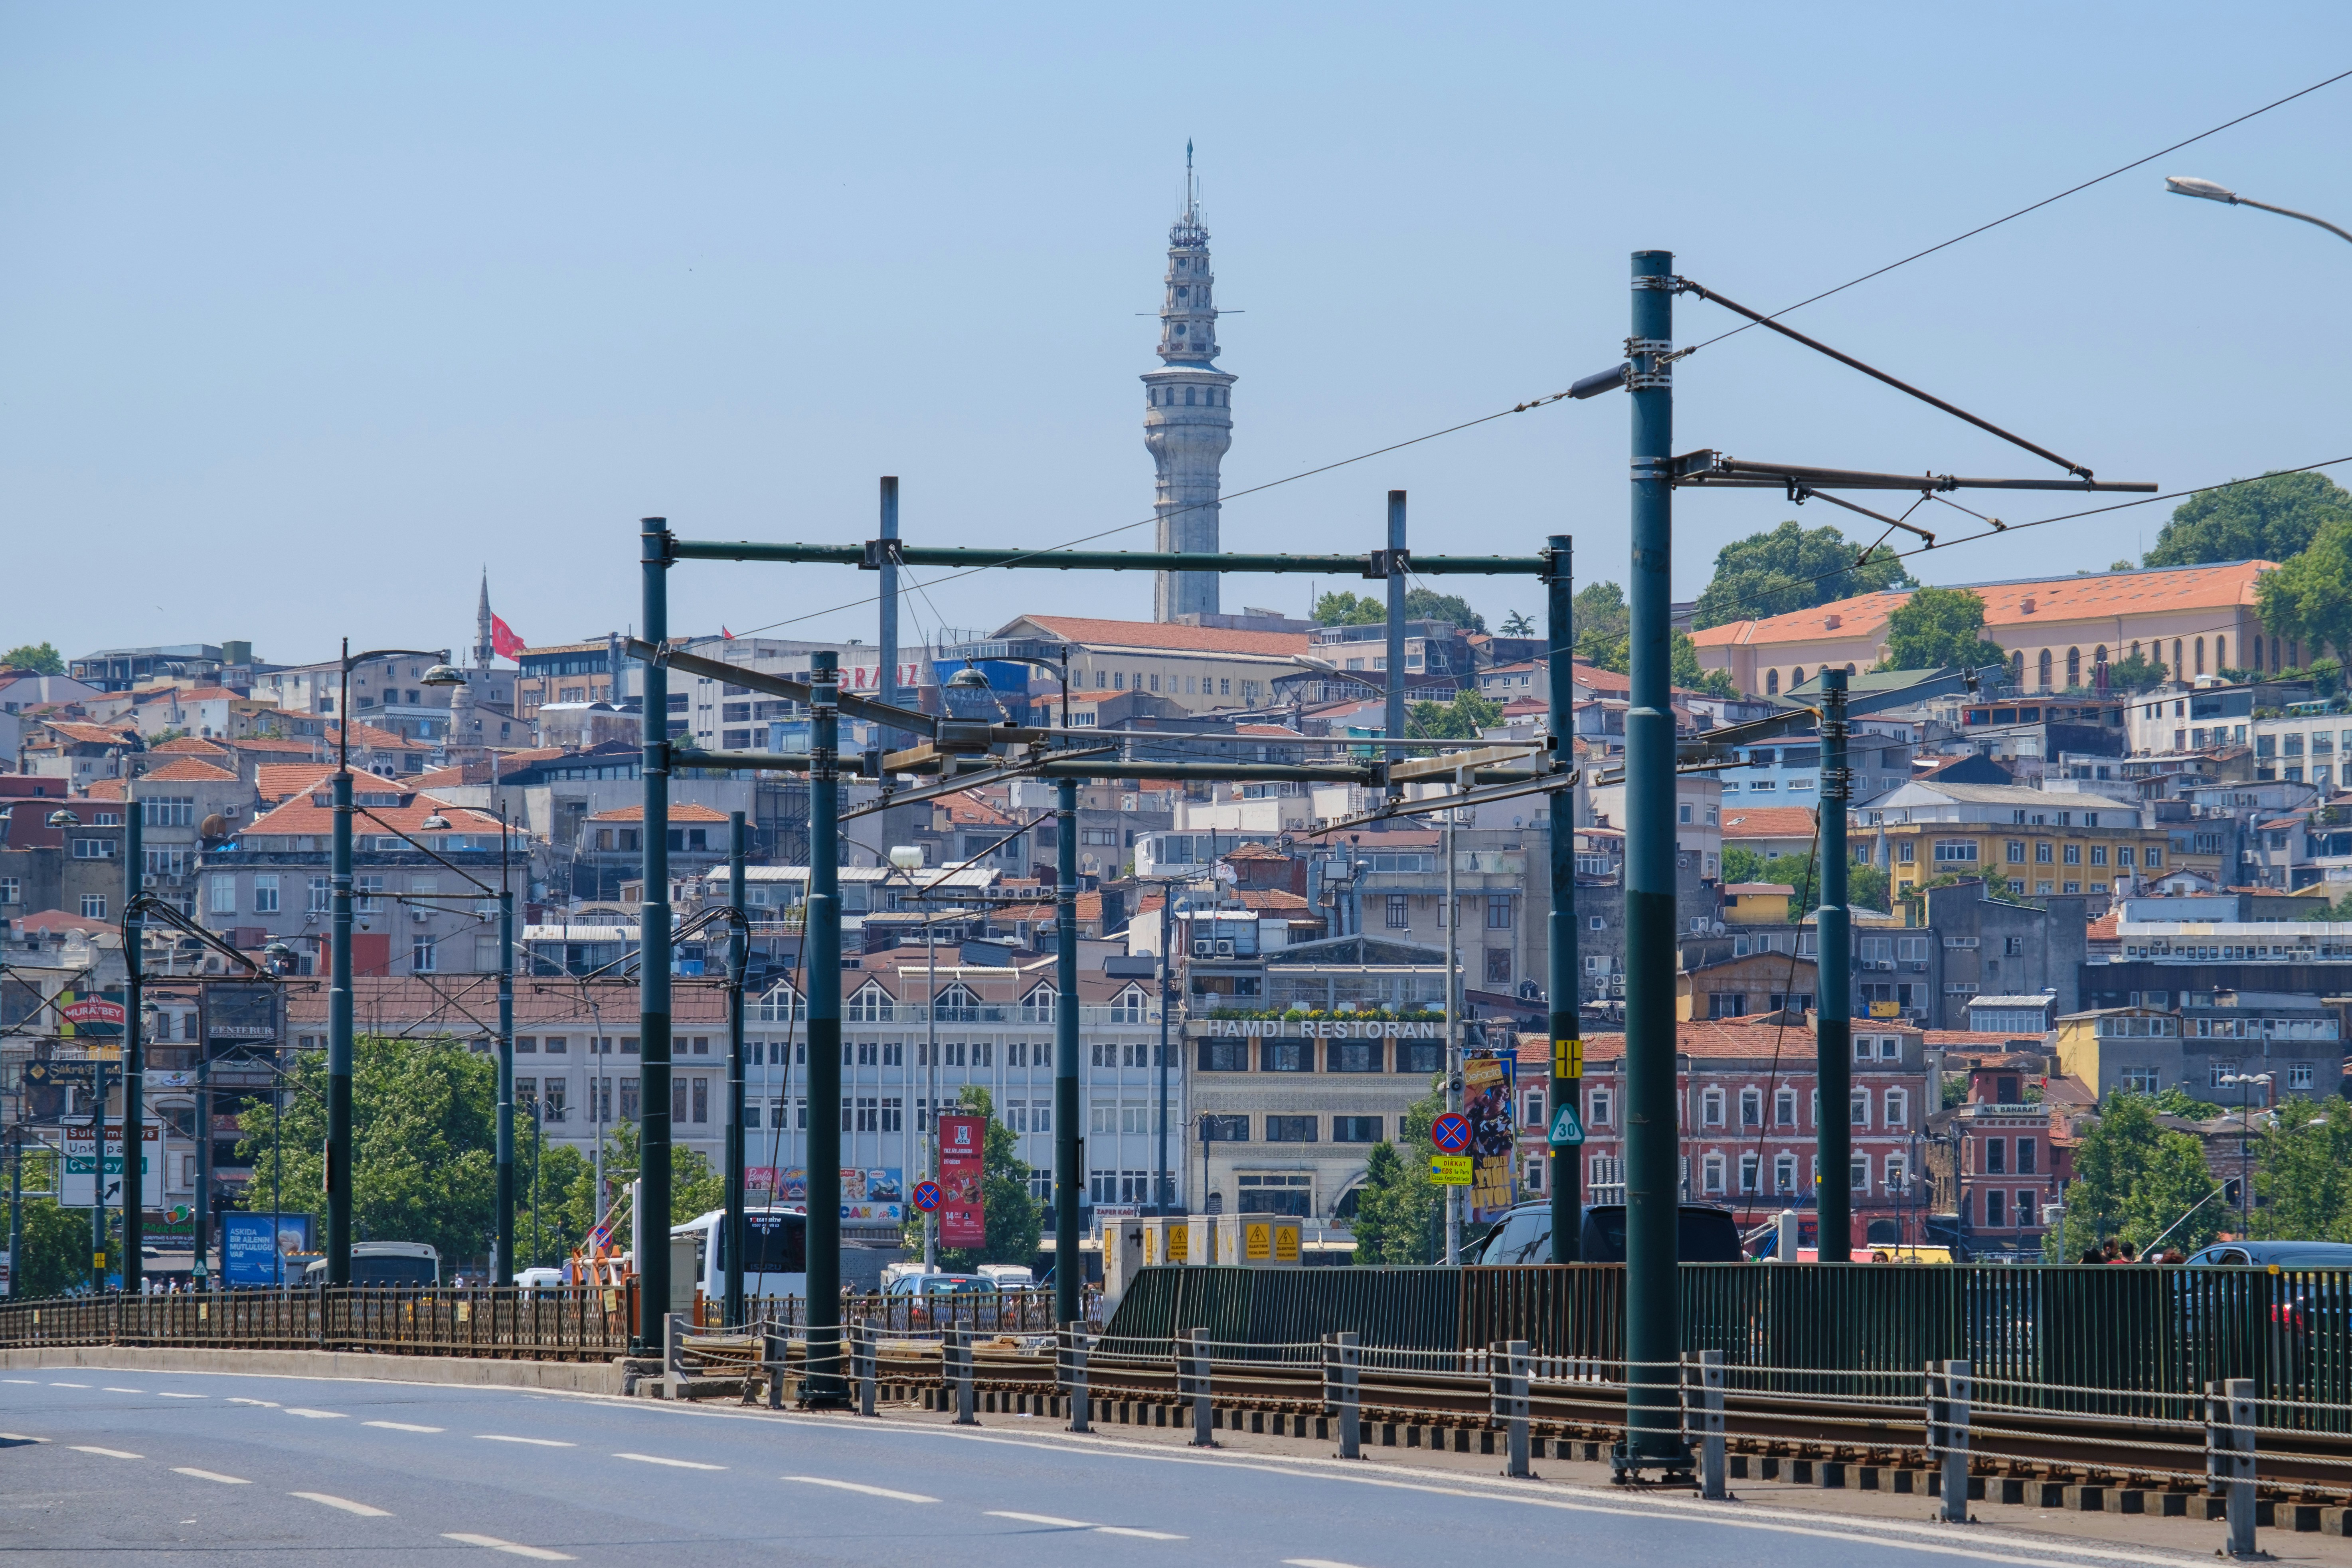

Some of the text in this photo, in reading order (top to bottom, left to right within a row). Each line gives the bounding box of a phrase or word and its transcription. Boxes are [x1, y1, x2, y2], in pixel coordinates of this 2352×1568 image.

[66, 1007, 121, 1017] MURATBEY
[1301, 1021, 1434, 1039] RESTORAN
[1465, 1068, 1501, 1082] DeFacto
[1559, 1123, 1575, 1137] 30
[1483, 1155, 1508, 1168] GÖMLEK
[748, 1168, 772, 1181] Barbie
[945, 1212, 954, 1220] 14
[230, 1242, 273, 1251] MUTLULUĞU
